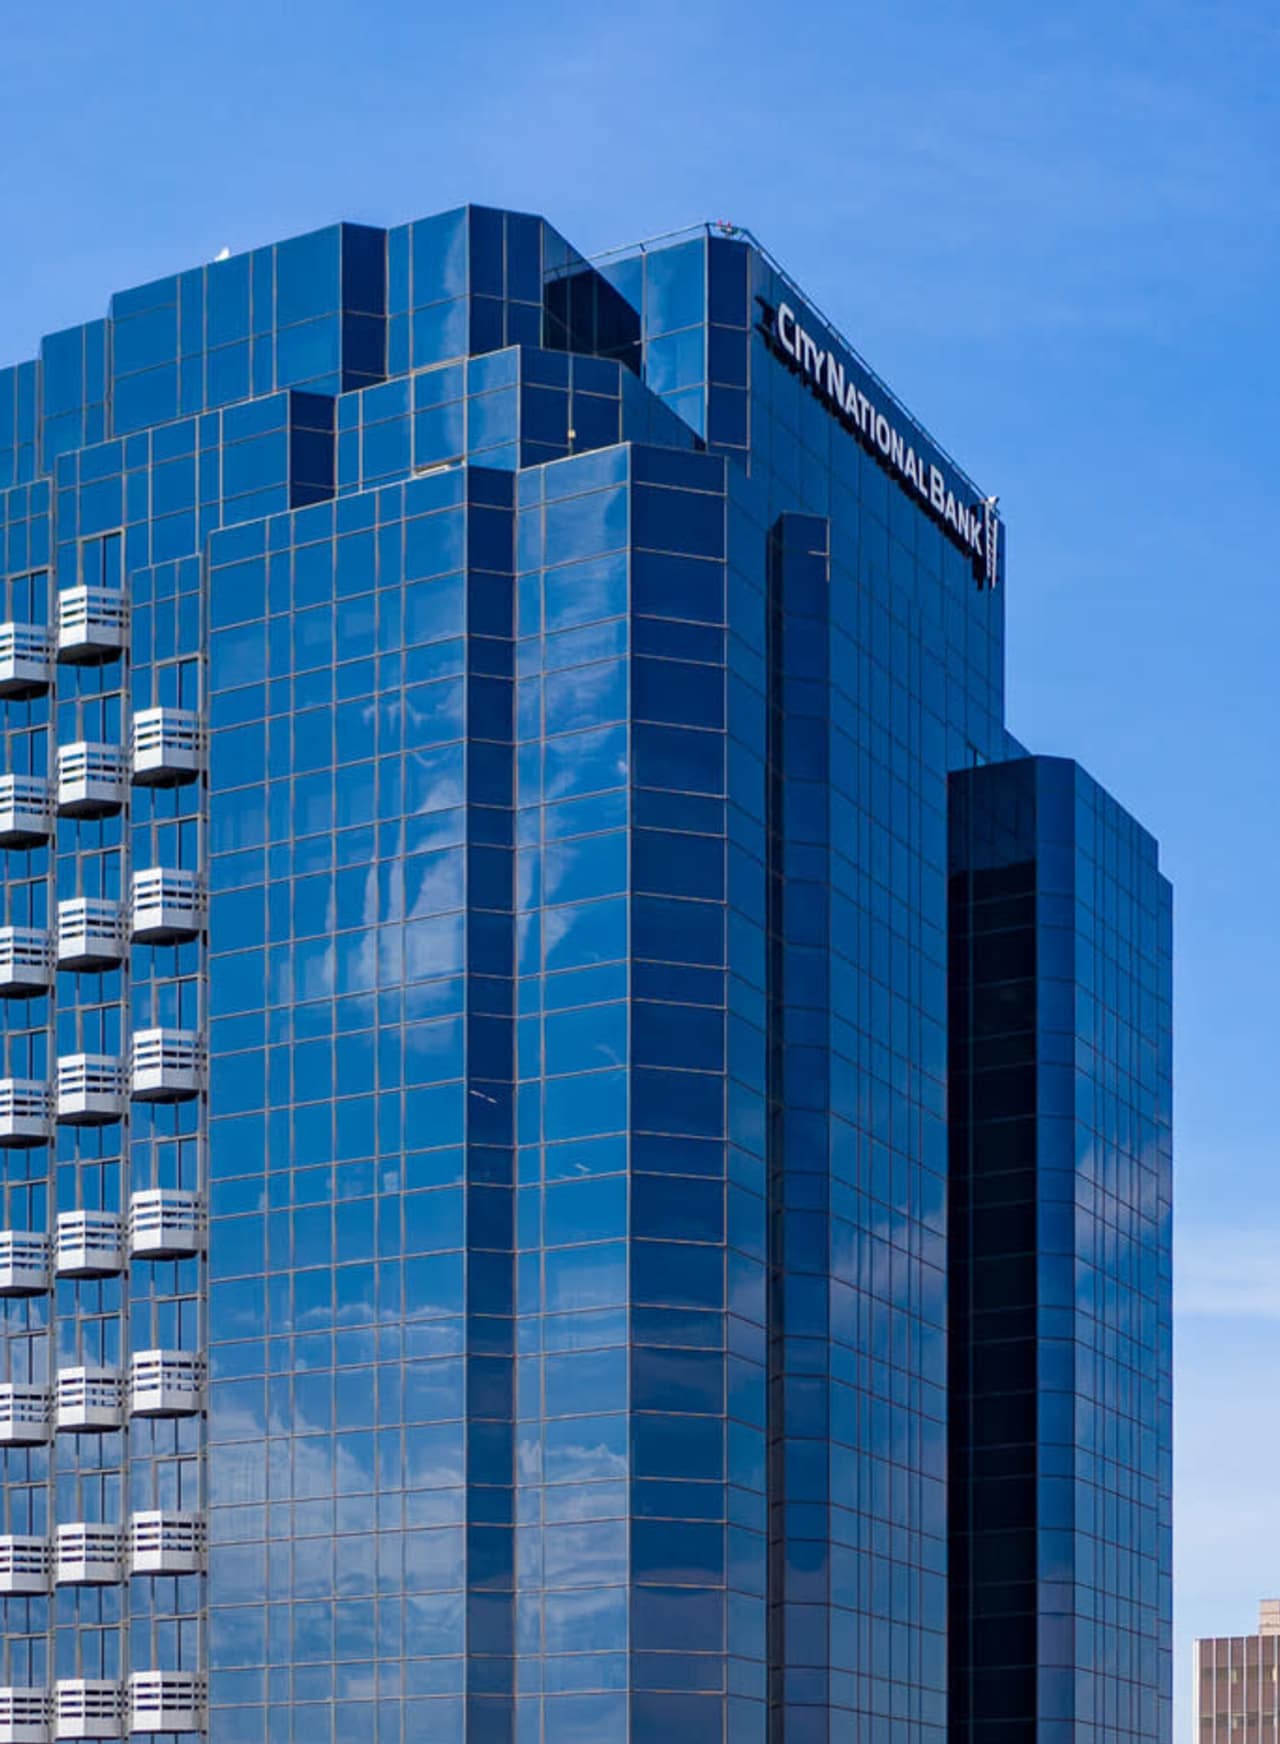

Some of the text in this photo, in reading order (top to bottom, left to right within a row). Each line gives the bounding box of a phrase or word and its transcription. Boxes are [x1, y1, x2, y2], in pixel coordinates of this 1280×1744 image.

[777, 303, 983, 556] CITY NATIONAL BANK
